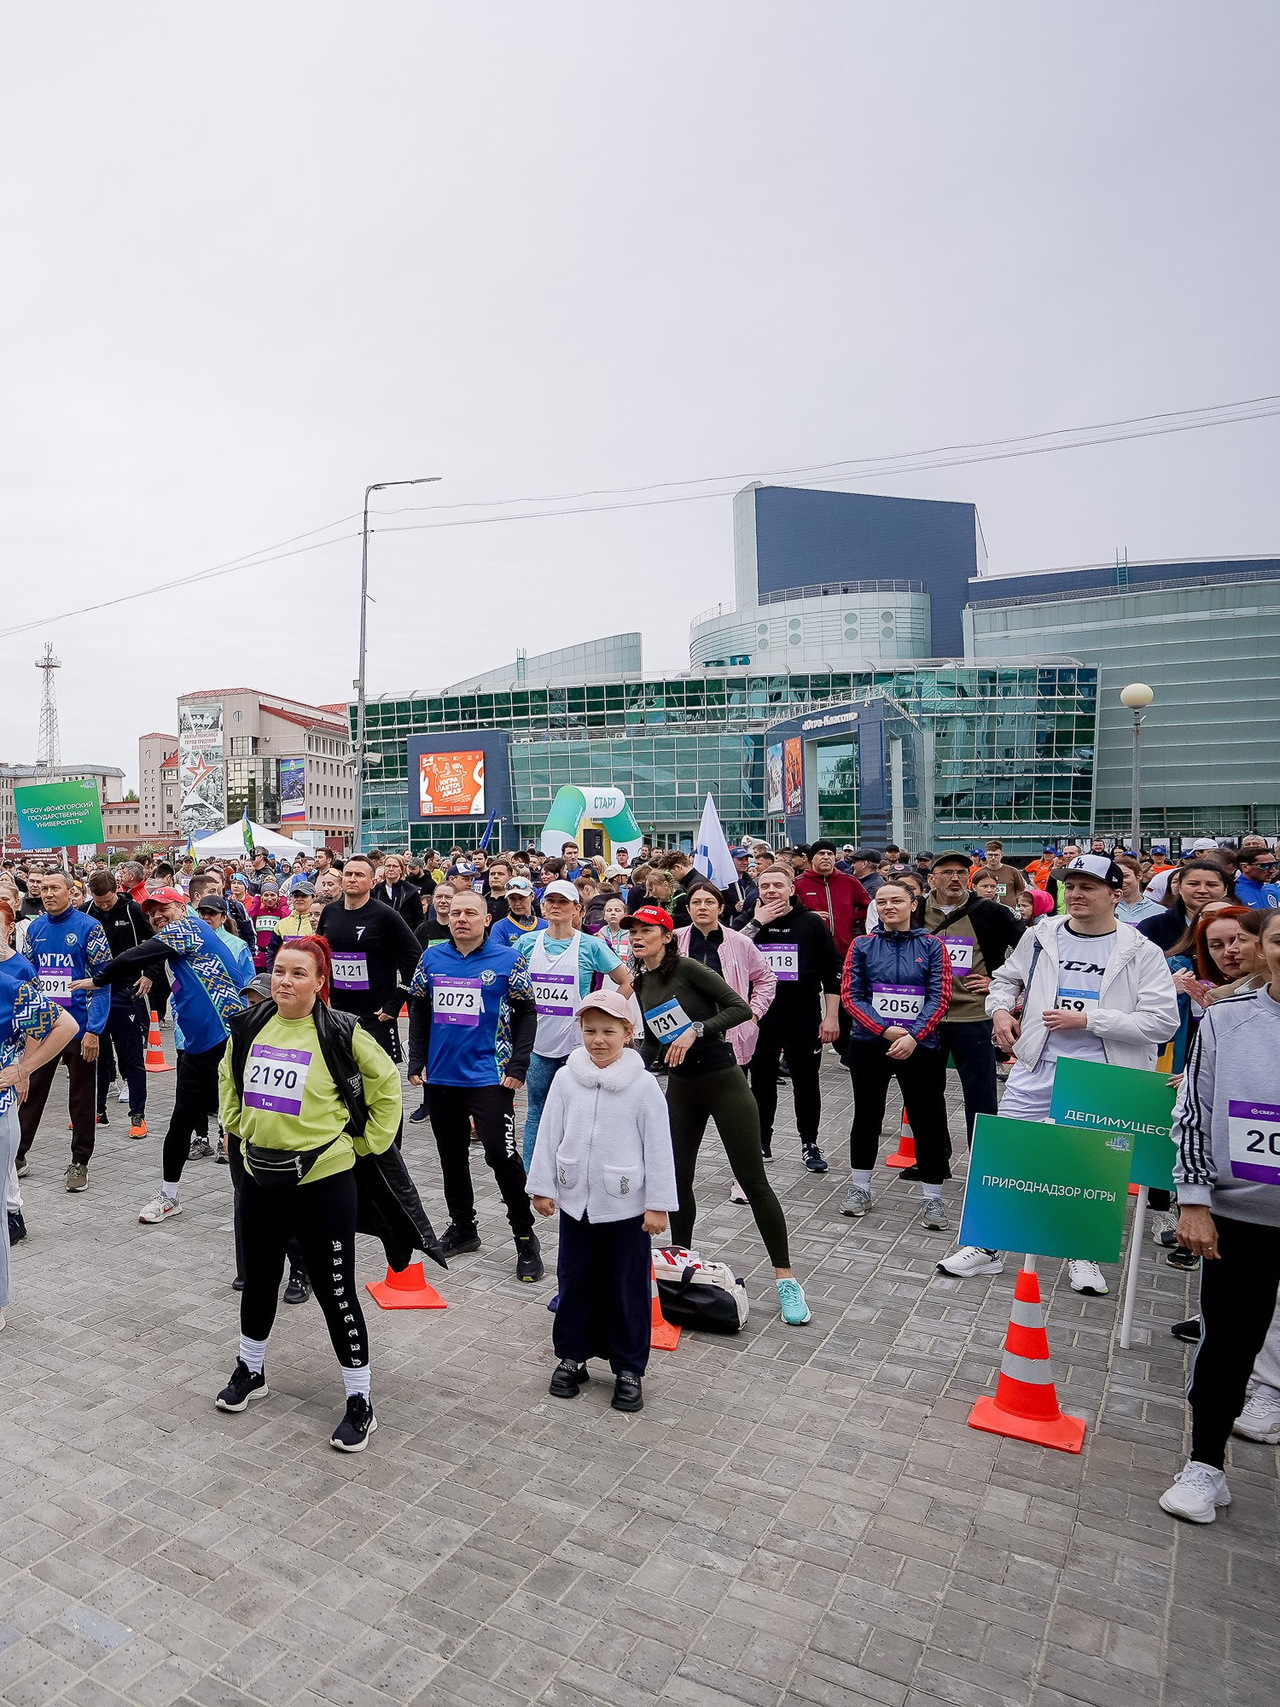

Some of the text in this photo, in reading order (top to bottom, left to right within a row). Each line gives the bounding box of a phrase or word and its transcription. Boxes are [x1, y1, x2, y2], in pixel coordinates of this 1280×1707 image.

[594, 797, 616, 809] СТАРТ
[28, 809, 89, 821] ГОСУДАРСТВЕННЫЙ
[37, 953, 74, 967] ЮГРА
[335, 965, 361, 976] 2121
[1059, 961, 1105, 976] CM
[40, 980, 66, 992] 2091
[438, 993, 474, 1007] 2073
[536, 987, 568, 1001] 2044
[880, 999, 919, 1013] 2056
[653, 1013, 678, 1033] 731
[250, 1065, 297, 1089] 2190
[505, 1123, 514, 1158] PUMA
[982, 1175, 1116, 1202] ПРИРОДНАДЗОР ЮГРЫ
